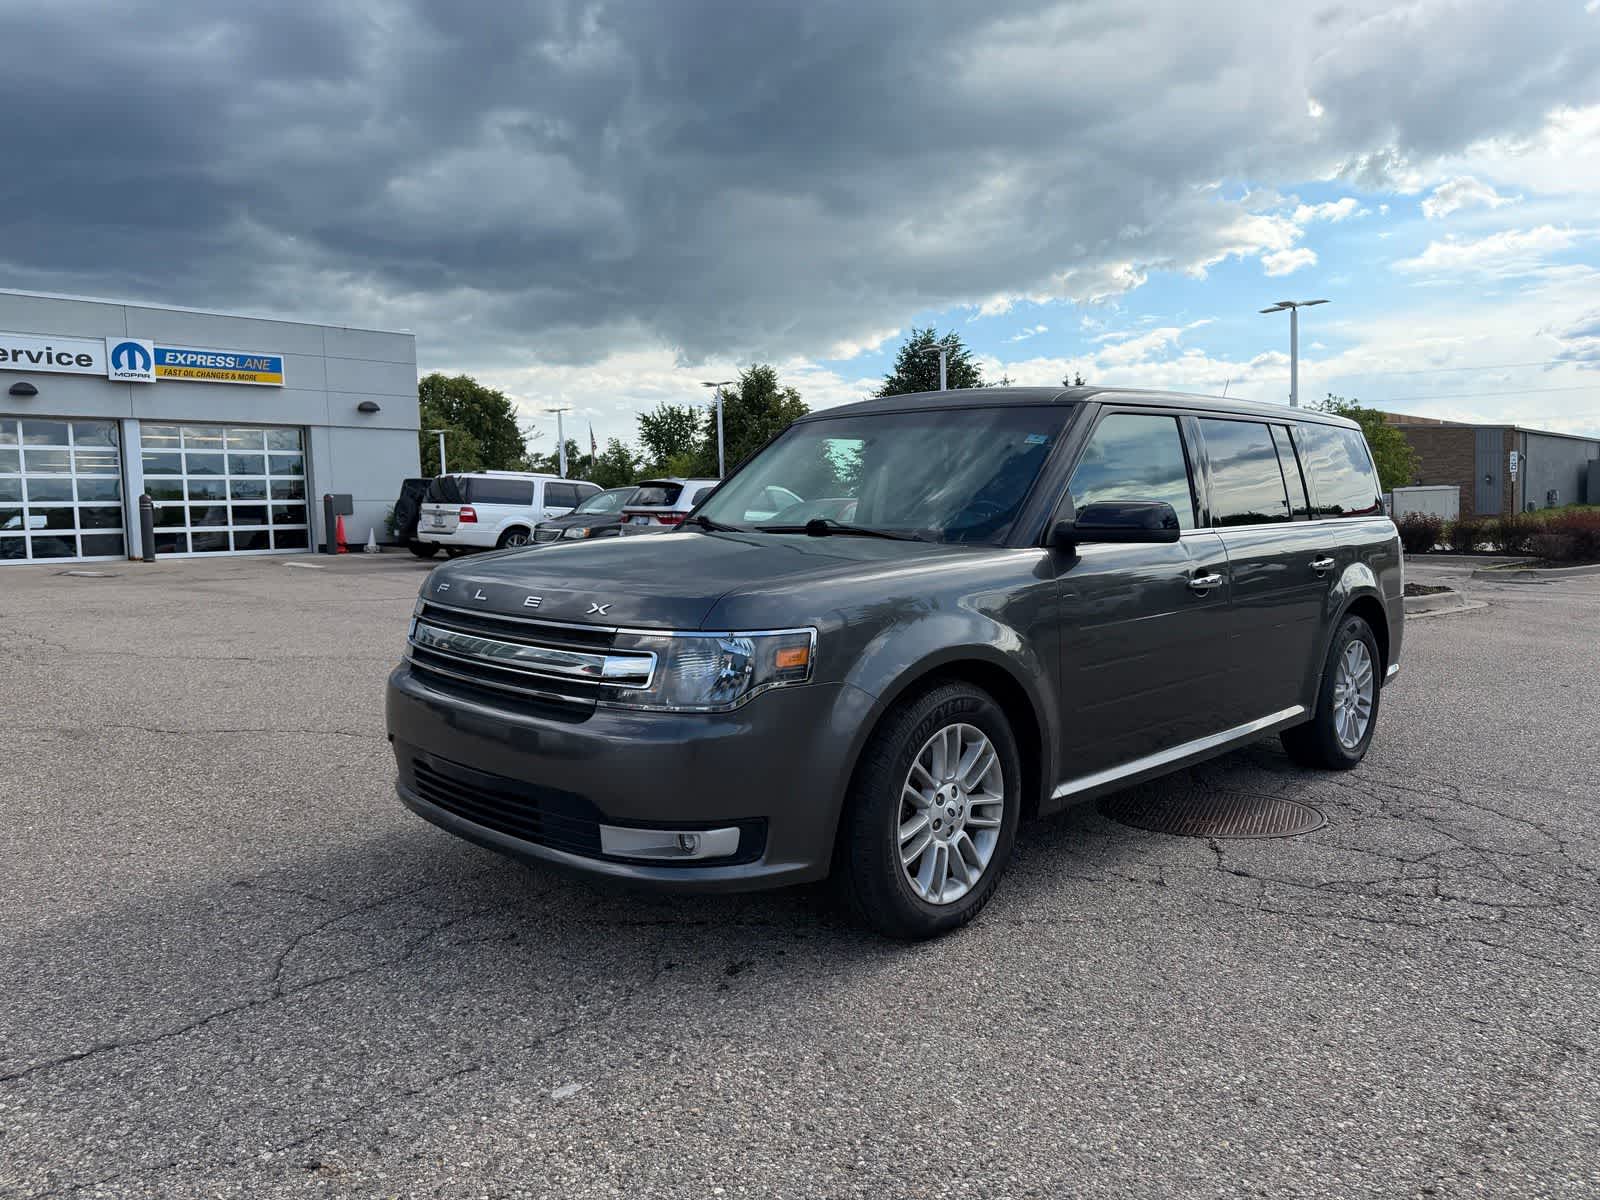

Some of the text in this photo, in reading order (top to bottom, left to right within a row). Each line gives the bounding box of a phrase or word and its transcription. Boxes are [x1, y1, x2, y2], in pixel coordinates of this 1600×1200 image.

[114, 371, 150, 379] MOPAR
[163, 368, 257, 381] FAST OIL CHANGES & MORE
